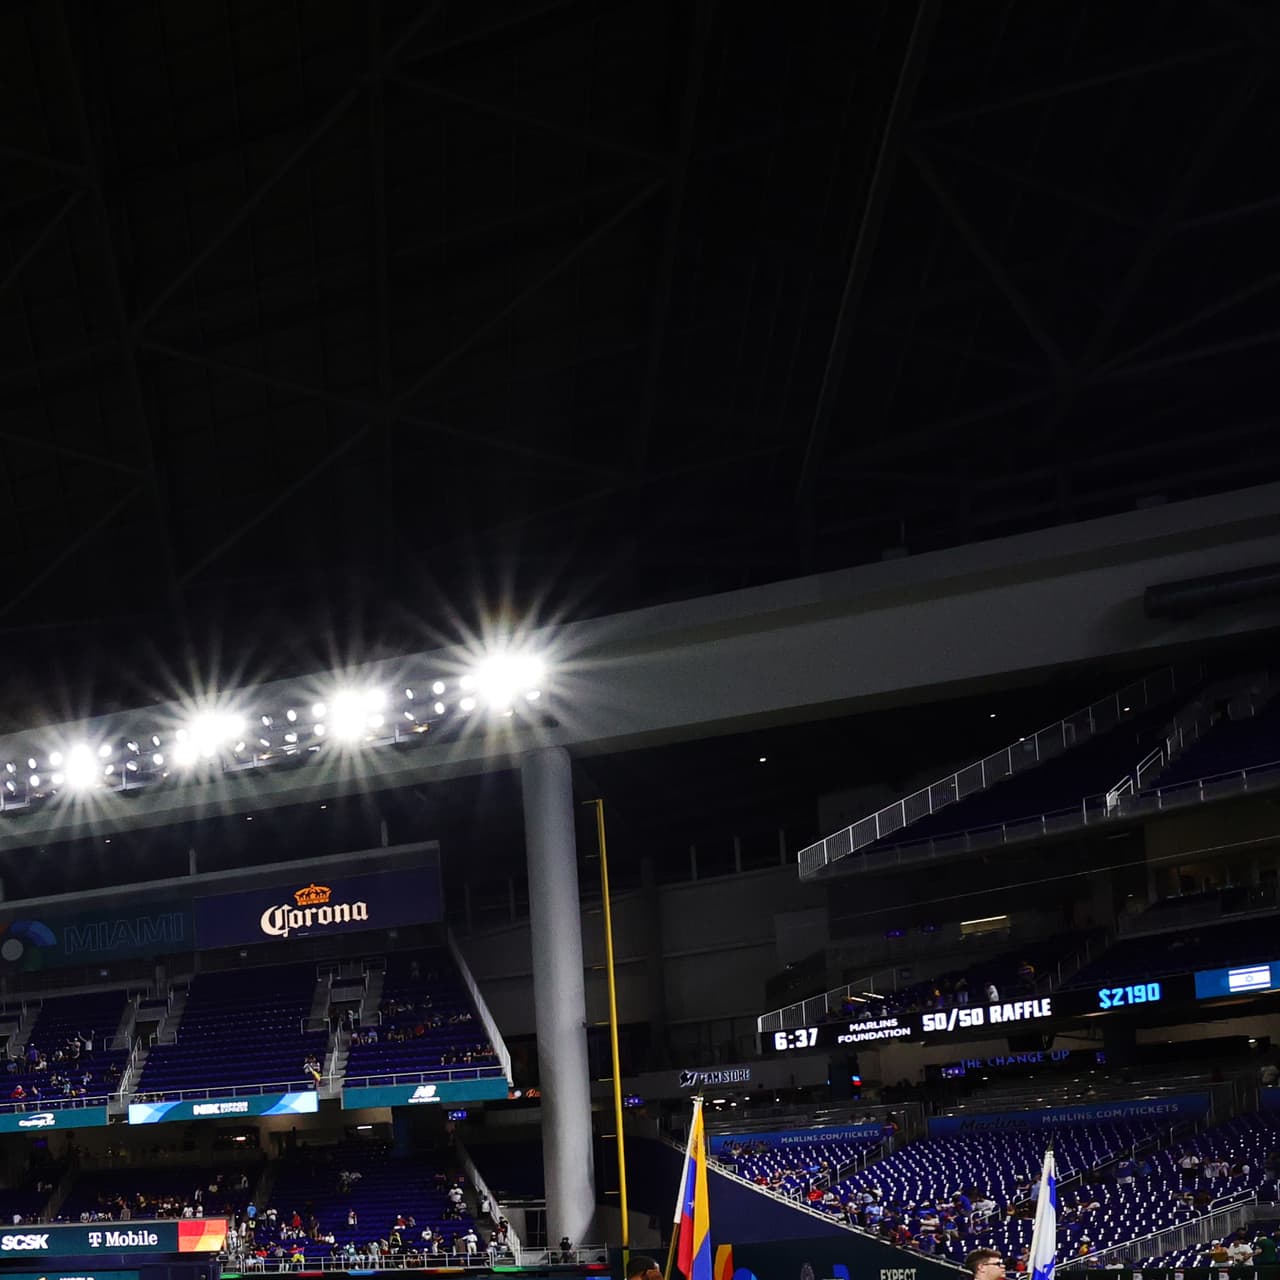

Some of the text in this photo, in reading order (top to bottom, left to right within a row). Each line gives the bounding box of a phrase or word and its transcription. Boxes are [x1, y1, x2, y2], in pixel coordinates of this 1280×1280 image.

[260, 901, 368, 938] Corona
[64, 912, 185, 953] MIAMI
[1098, 983, 1161, 1009] $2190
[922, 998, 1053, 1032] 50/50 RAFFLE
[849, 1018, 898, 1032] MARLINS
[774, 1028, 818, 1050] 6:37
[838, 1027, 911, 1044] FOUNDATION
[988, 1052, 1043, 1067] CHANGE
[1051, 1050, 1070, 1061] UP
[721, 1069, 751, 1083] STORE
[1042, 1104, 1178, 1122] MARLINS.COM/TICKETS
[781, 1129, 880, 1144] MARLINS.COM/TICKETS
[1, 1234, 51, 1250] SCSK
[105, 1230, 158, 1247] Mobile
